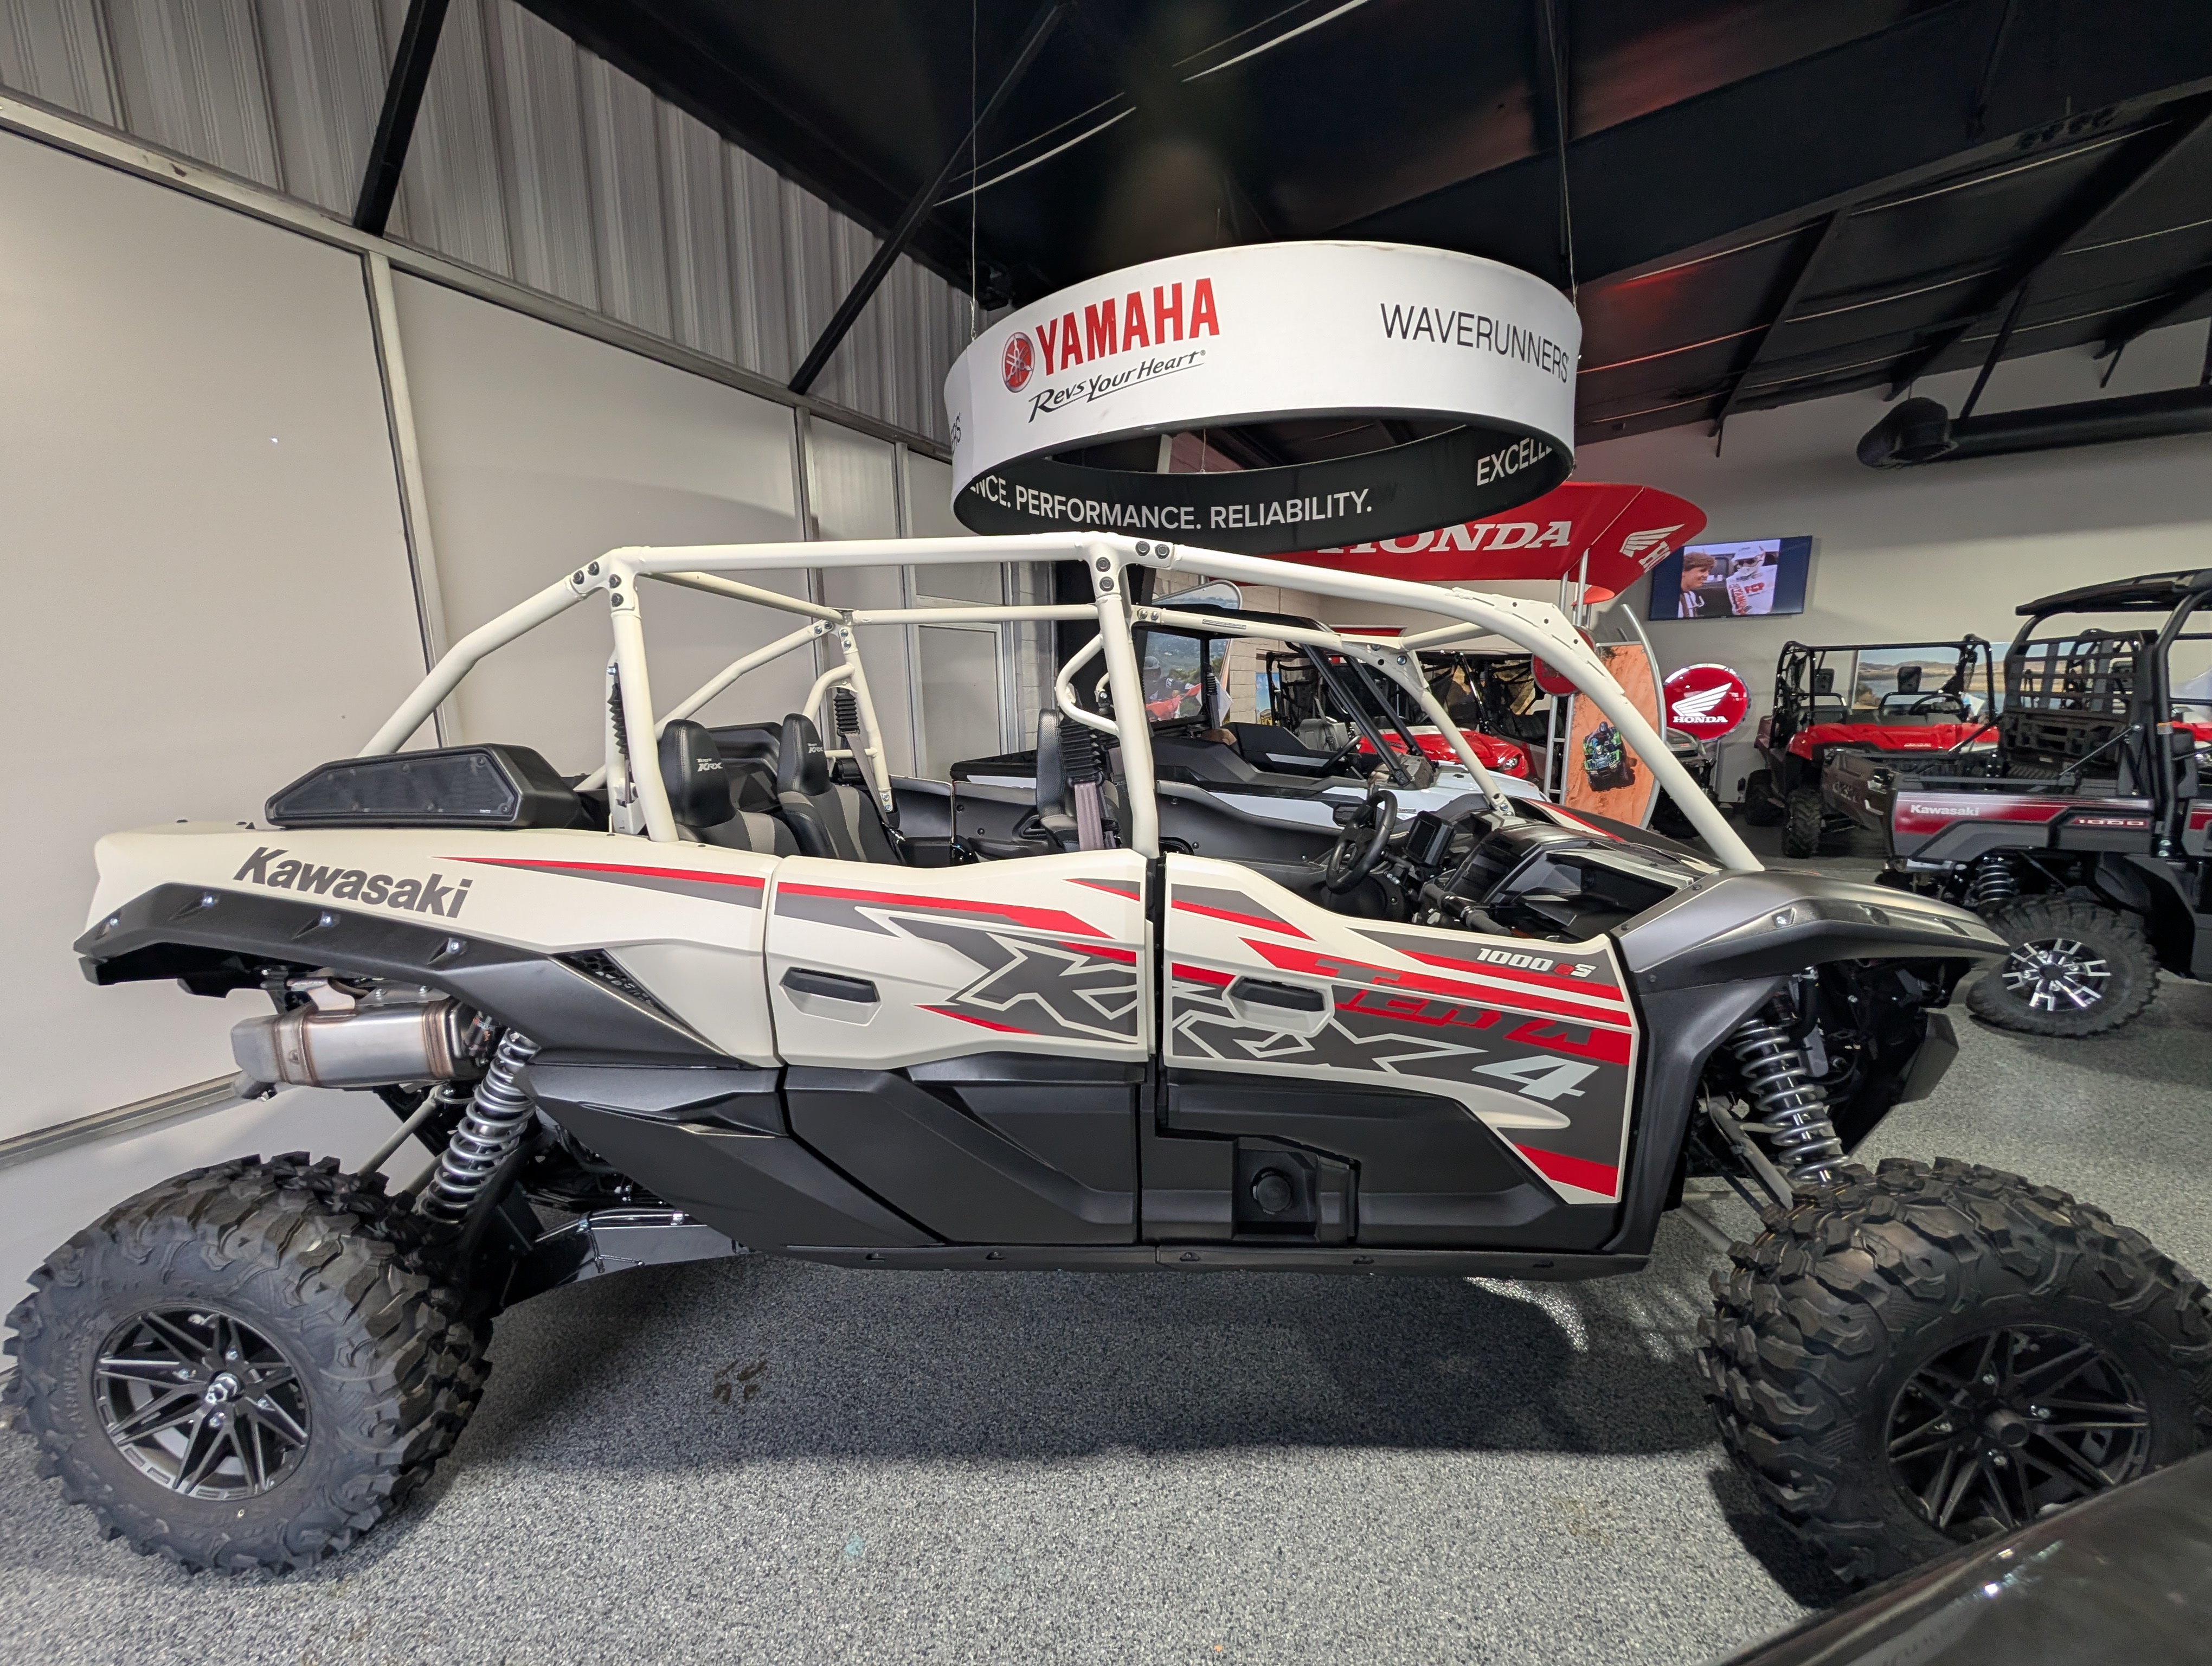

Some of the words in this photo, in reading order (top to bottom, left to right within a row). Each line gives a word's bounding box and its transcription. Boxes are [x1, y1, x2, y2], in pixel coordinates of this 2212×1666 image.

[1036, 277, 1220, 376] YAMAHA
[1380, 303, 1567, 383] WAVERUNNERS
[1028, 380, 1086, 424] Revs
[1086, 368, 1137, 403] Your
[1015, 484, 1201, 529] PERFORMANCE.
[1210, 488, 1372, 528] RELIABILITY.
[1910, 804, 1980, 816] Kawasaki
[233, 847, 473, 919] Kawasaki
[1476, 947, 1554, 972] 1000
